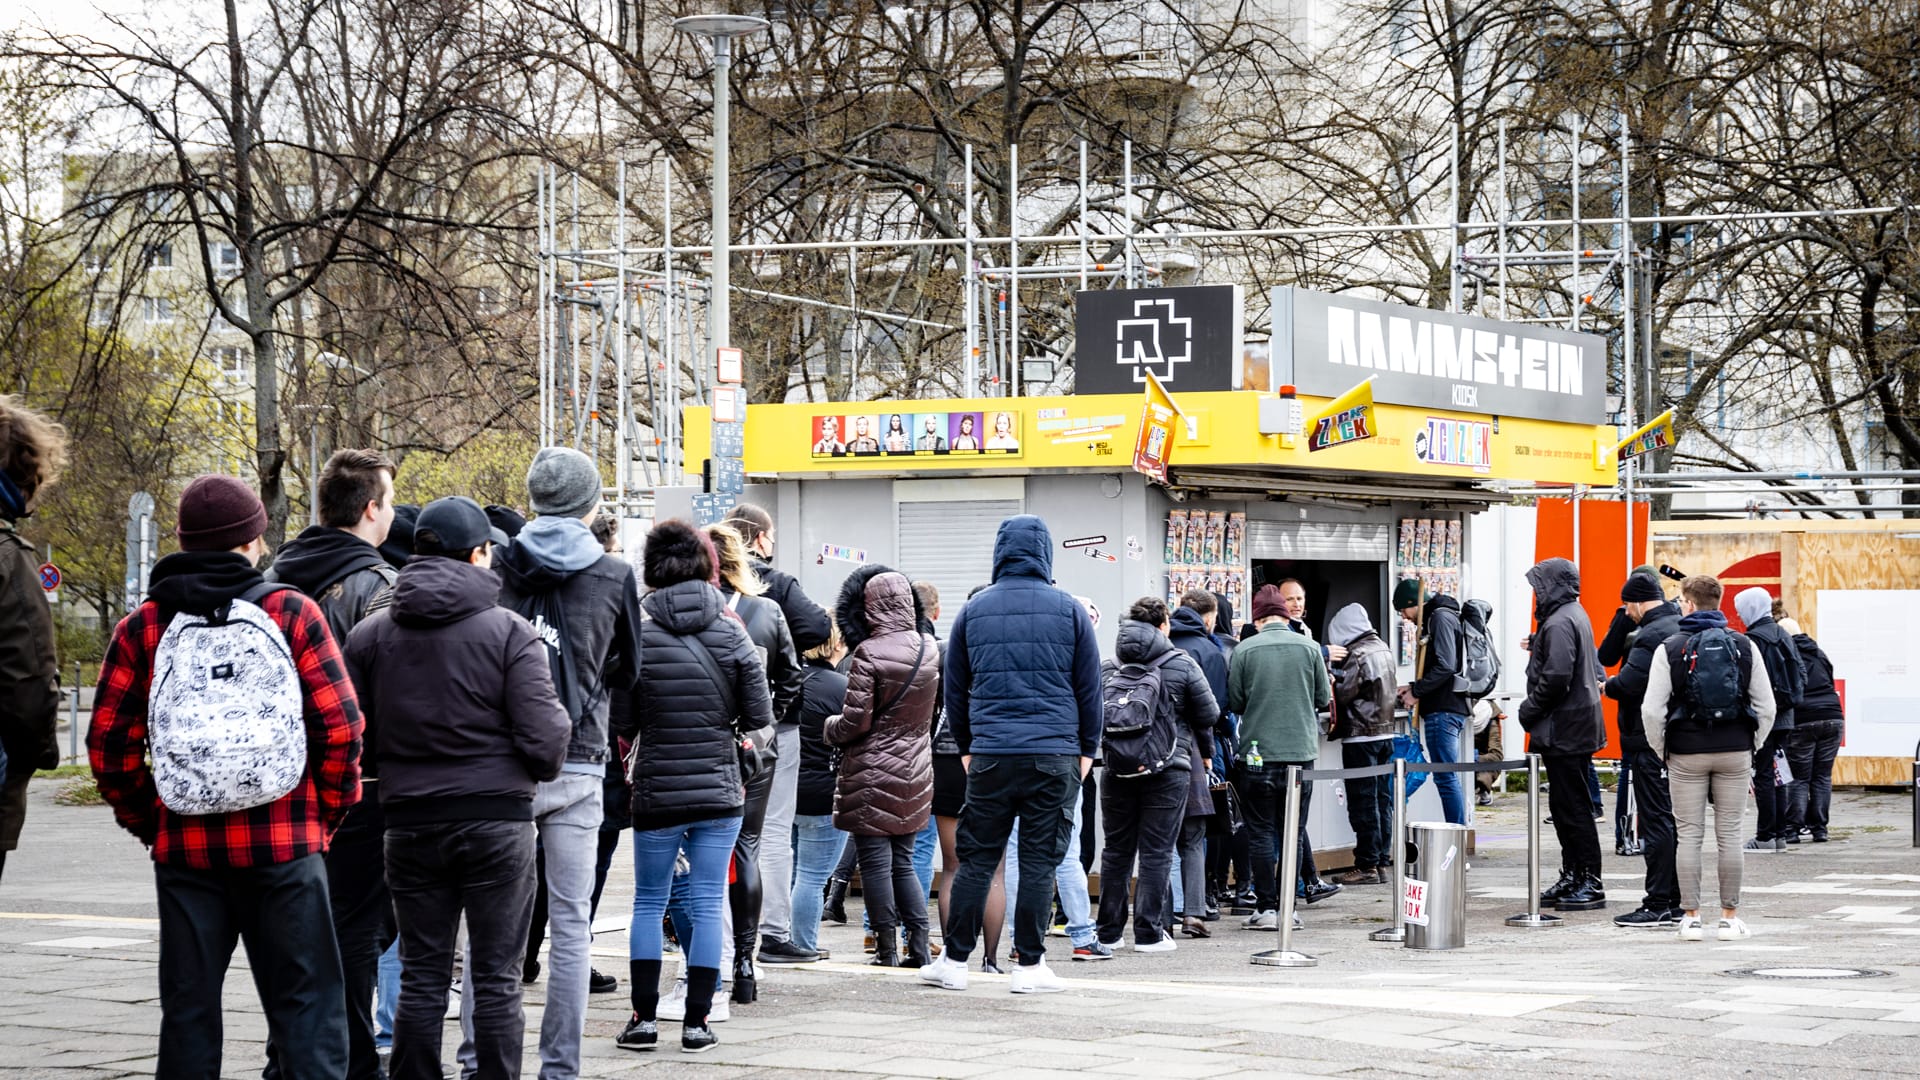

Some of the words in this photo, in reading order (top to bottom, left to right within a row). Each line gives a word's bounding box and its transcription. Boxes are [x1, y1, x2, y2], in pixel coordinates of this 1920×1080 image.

[1327, 306, 1582, 396] RAMMSTEIN
[1451, 384, 1477, 407] KIOSK
[1317, 417, 1370, 447] ZACK
[1428, 420, 1456, 462] ZICK
[1458, 423, 1490, 466] ZACK
[1625, 432, 1668, 457] ZACK
